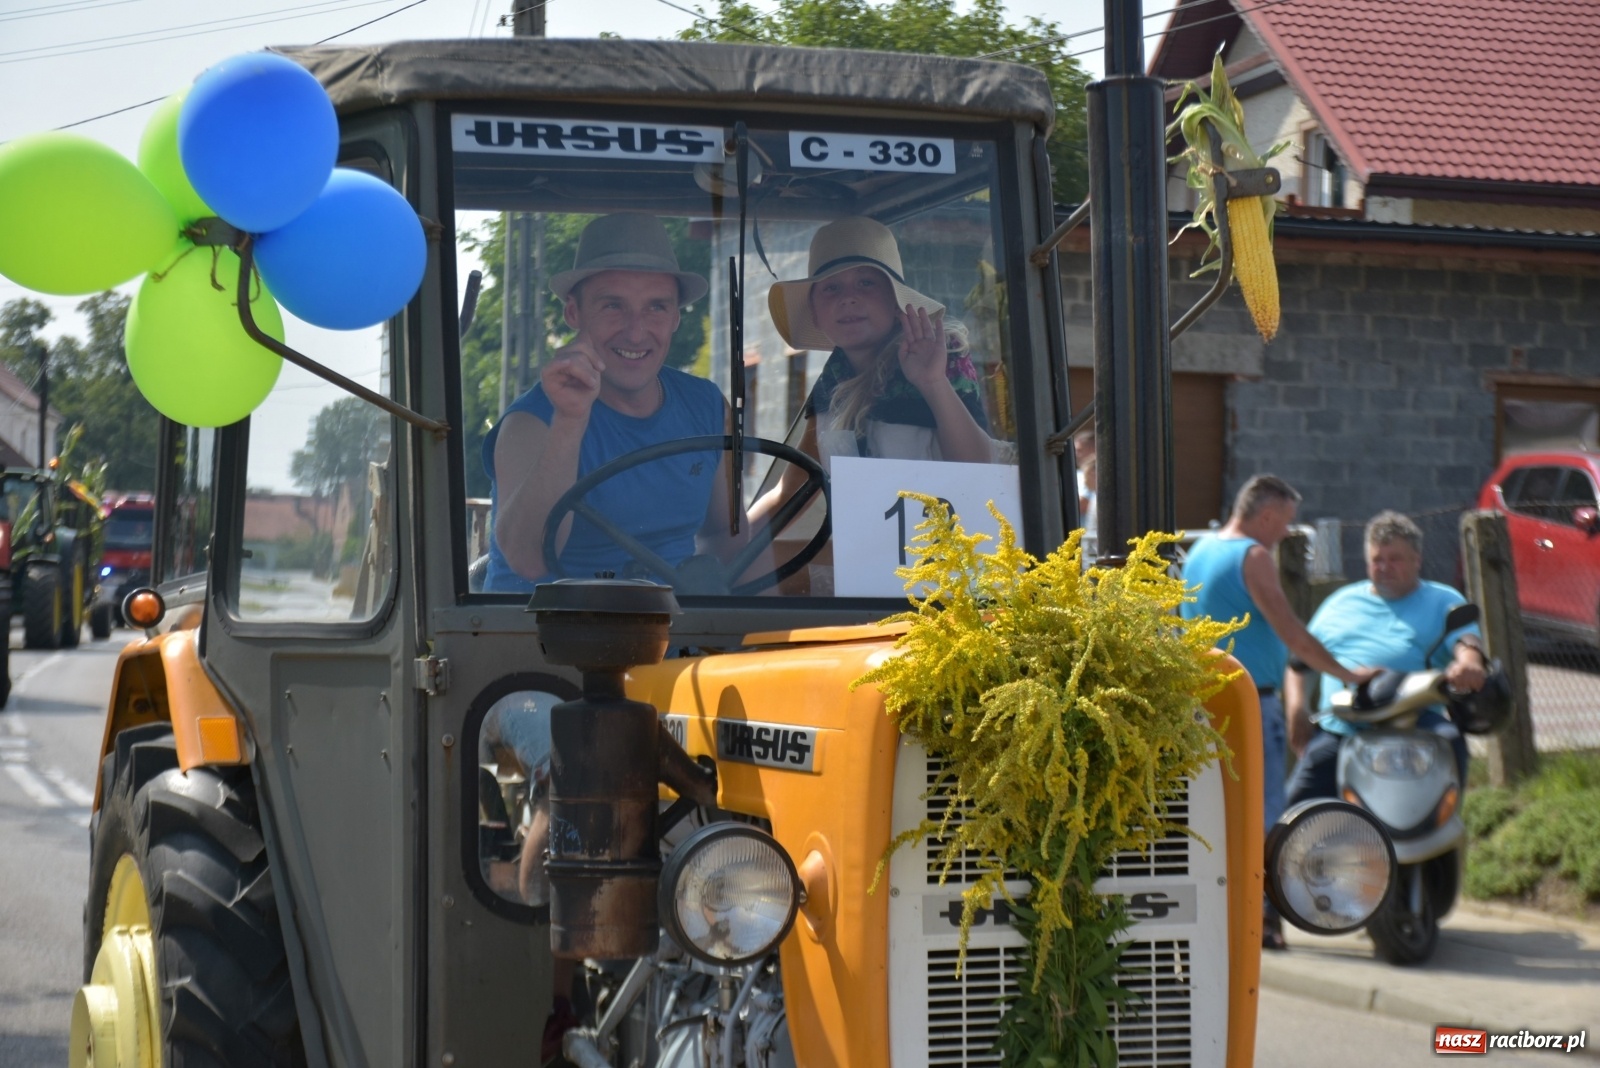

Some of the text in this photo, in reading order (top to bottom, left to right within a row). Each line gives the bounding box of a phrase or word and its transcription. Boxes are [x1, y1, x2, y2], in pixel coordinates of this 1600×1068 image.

[465, 120, 715, 156] URSUS
[800, 136, 829, 162] C
[869, 139, 942, 167] 330
[723, 723, 811, 765] URSUS
